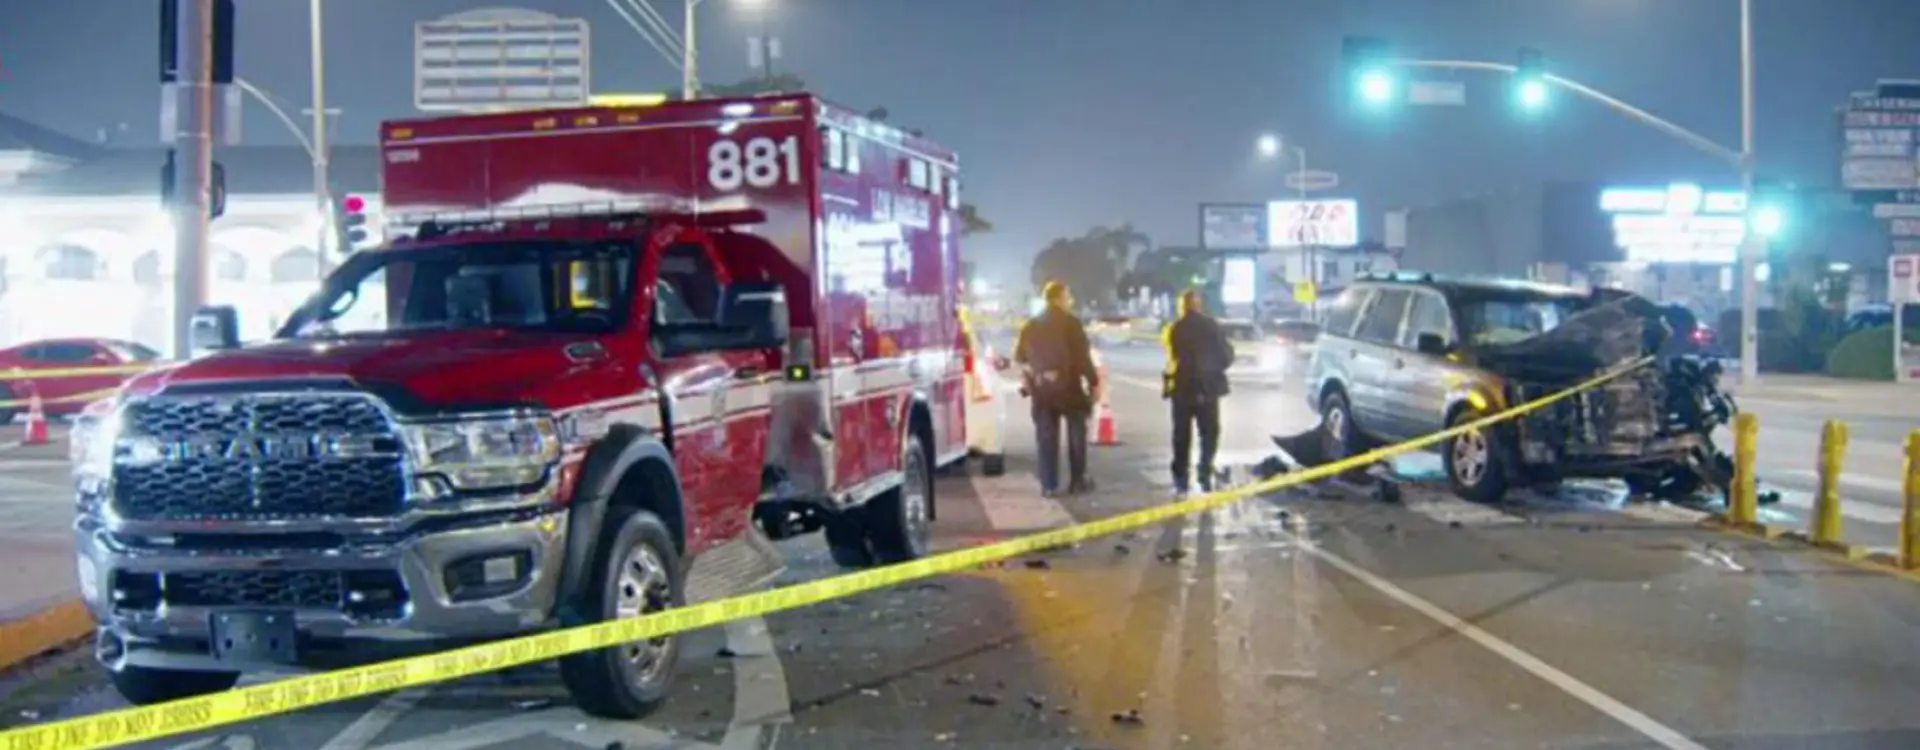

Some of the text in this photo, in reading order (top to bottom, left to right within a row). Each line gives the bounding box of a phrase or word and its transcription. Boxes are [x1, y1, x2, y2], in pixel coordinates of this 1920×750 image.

[708, 136, 801, 191] 881
[244, 663, 407, 715] FIRE LINE DO NOT CROSS
[53, 722, 89, 750] LINE
[96, 716, 120, 741] DO
[125, 709, 155, 735] NOT
[161, 701, 213, 729] CROSS
